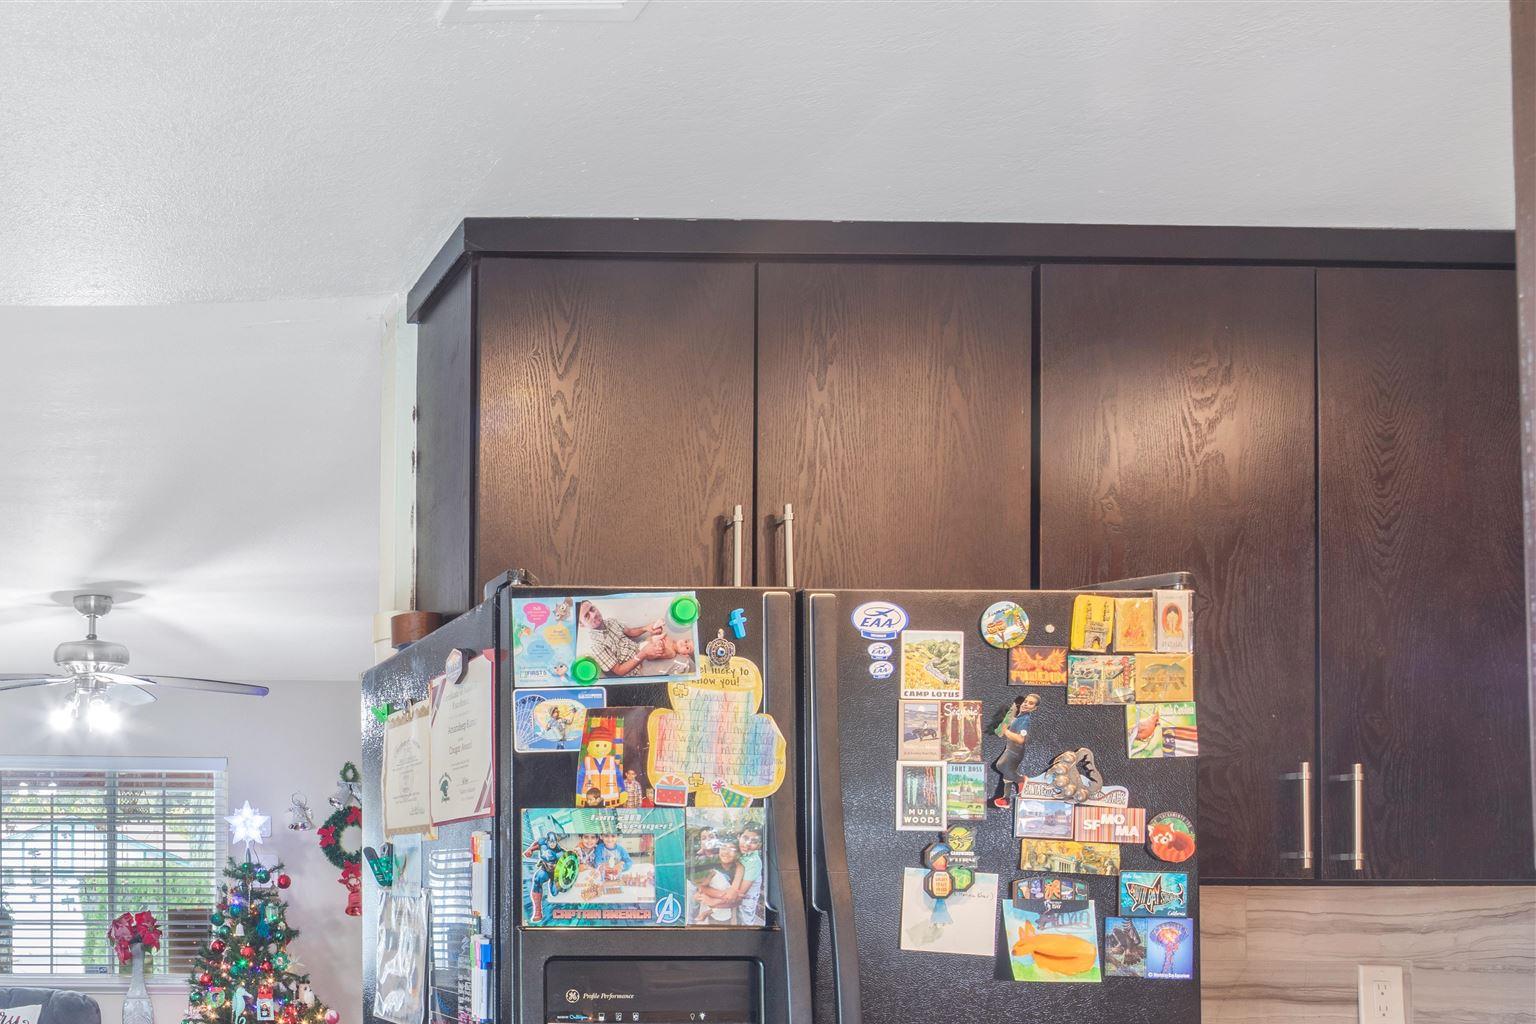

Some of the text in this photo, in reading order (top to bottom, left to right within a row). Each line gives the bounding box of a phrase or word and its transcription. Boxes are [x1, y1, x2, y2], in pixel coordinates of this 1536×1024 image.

[860, 617, 894, 628] EAA
[720, 677, 740, 688] you!
[1084, 814, 1125, 830] SF MO
[1115, 826, 1139, 836] MA
